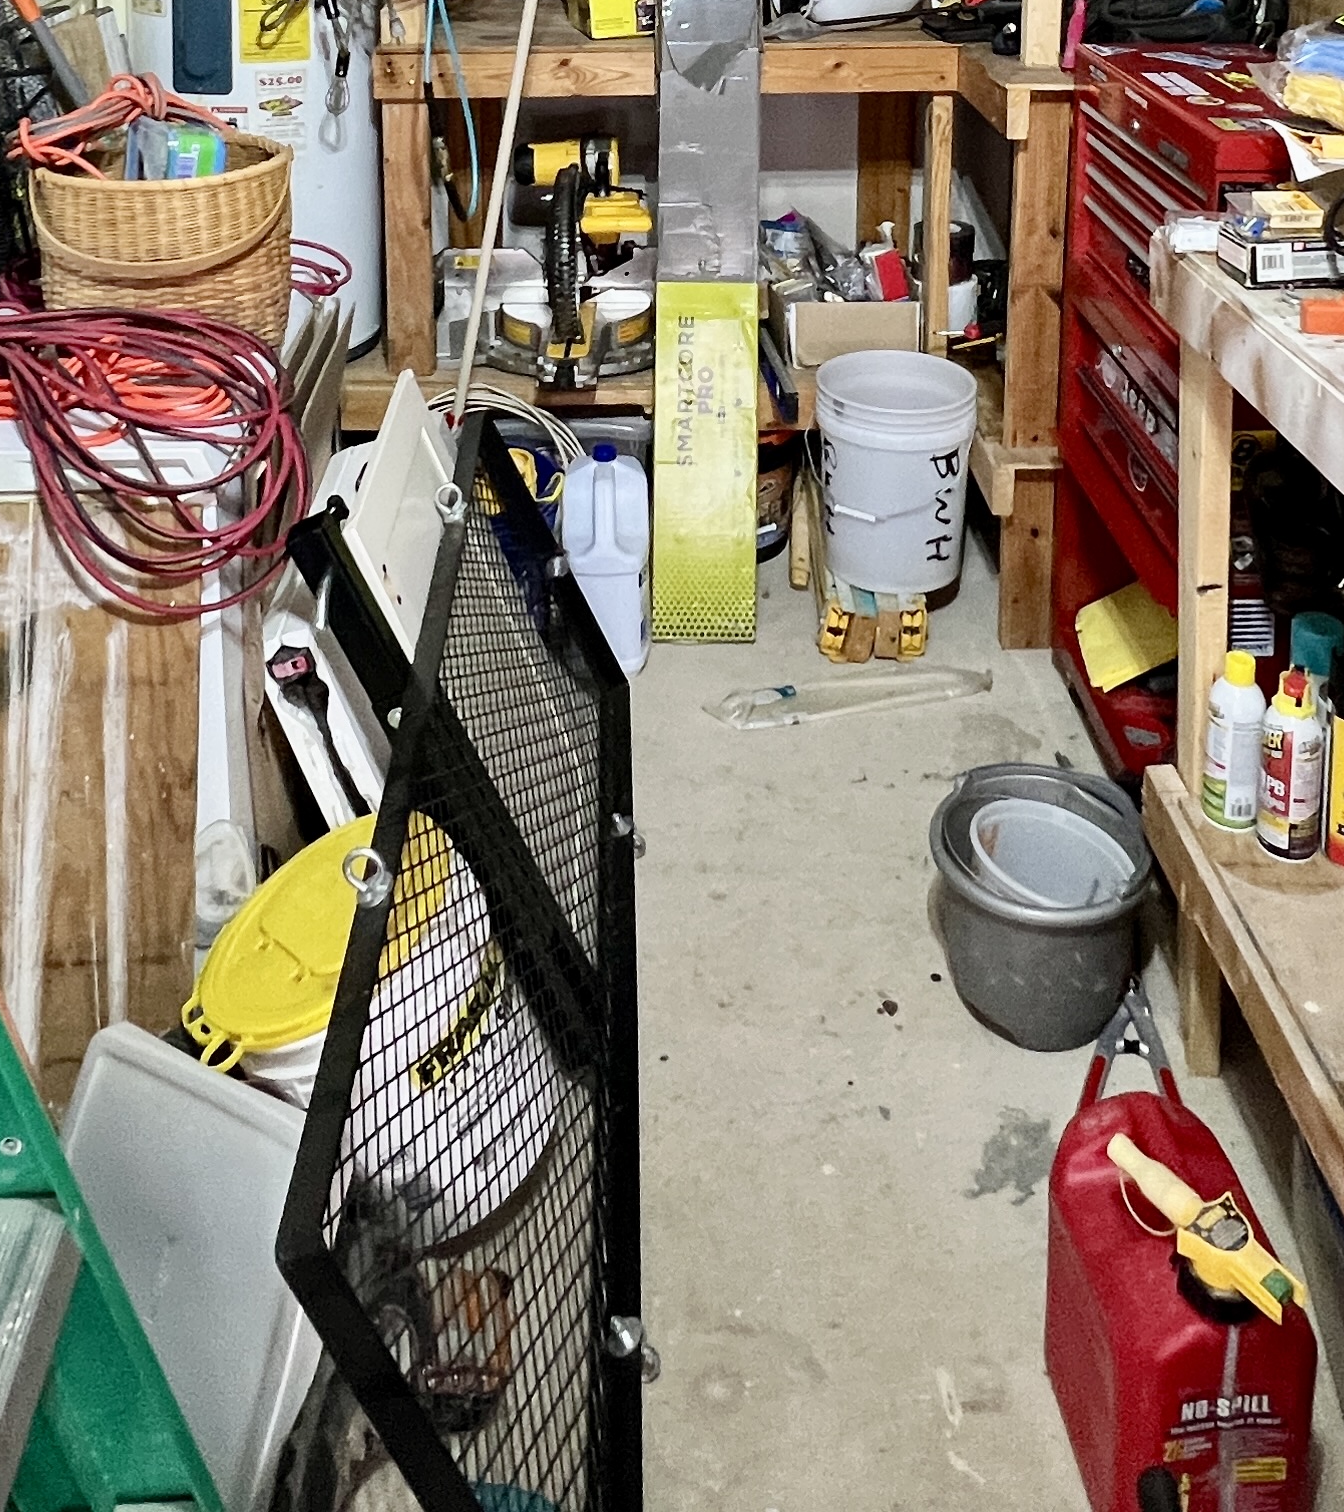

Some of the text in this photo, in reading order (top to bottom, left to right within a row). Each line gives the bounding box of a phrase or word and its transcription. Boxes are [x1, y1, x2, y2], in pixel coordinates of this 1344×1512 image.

[677, 315, 696, 467] SMARTCORE
[697, 366, 714, 415] PRO
[1181, 1394, 1271, 1422] NO-SPILL
